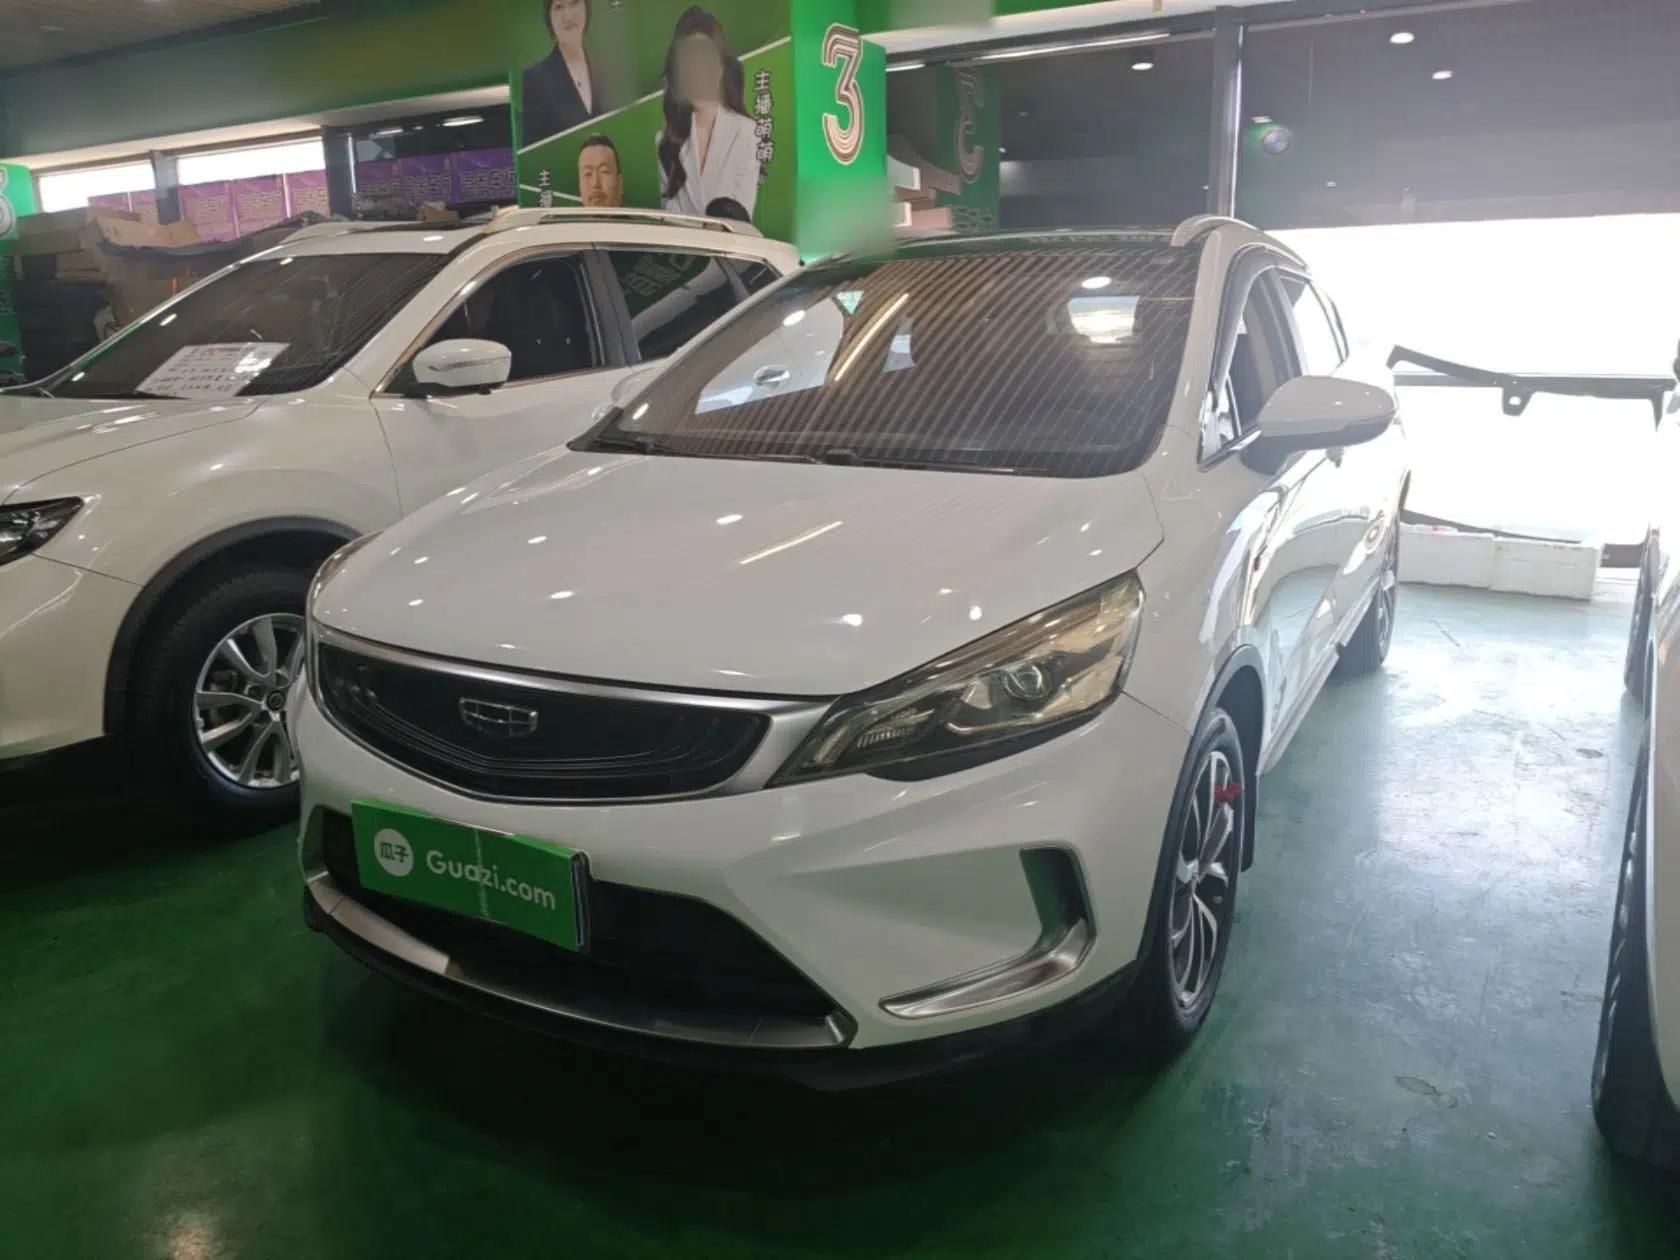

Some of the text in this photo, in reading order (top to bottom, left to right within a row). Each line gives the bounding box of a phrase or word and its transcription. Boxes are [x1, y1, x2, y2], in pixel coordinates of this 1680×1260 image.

[822, 23, 865, 165] 3
[379, 841, 410, 864] 瓜子
[426, 850, 556, 910] Guazi.com
